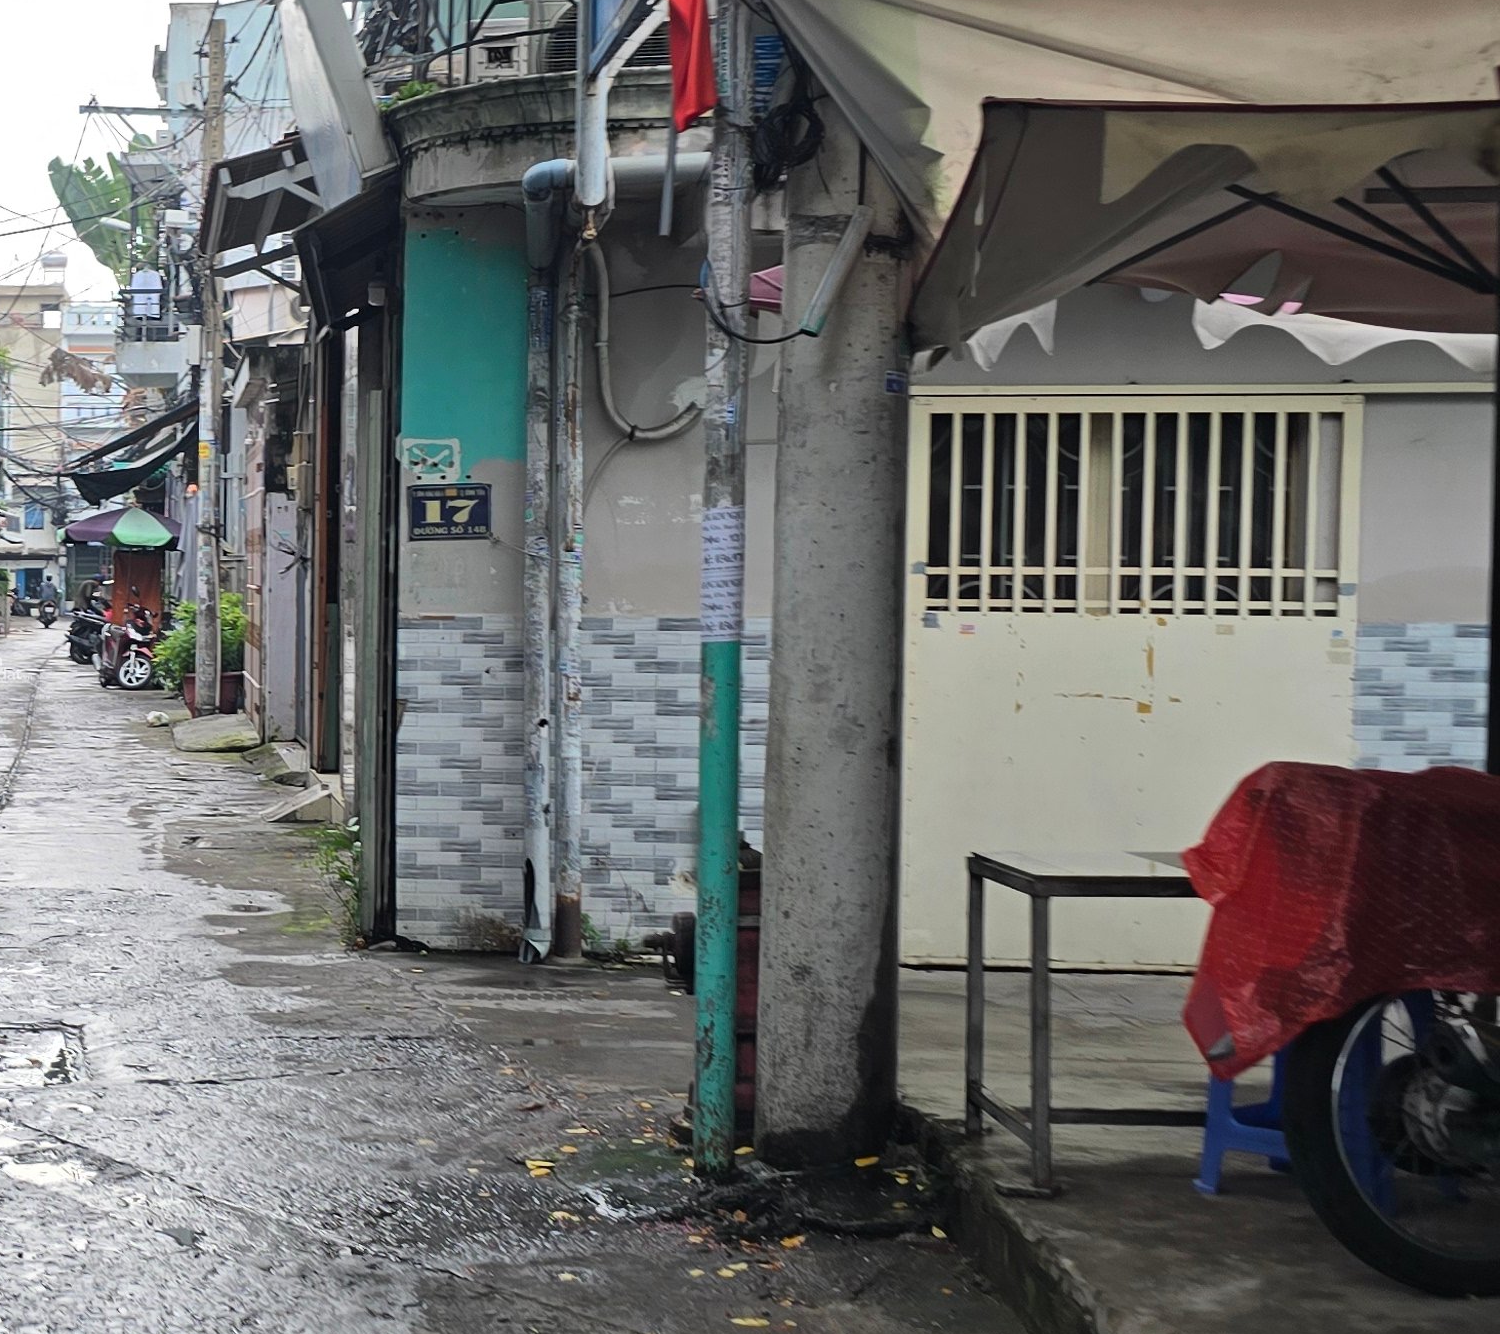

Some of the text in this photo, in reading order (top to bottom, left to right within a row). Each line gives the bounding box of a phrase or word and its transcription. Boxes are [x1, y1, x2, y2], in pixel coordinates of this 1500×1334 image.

[420, 499, 479, 524] 17
[413, 524, 487, 535] ĐƯỜNG SỐ 14B
